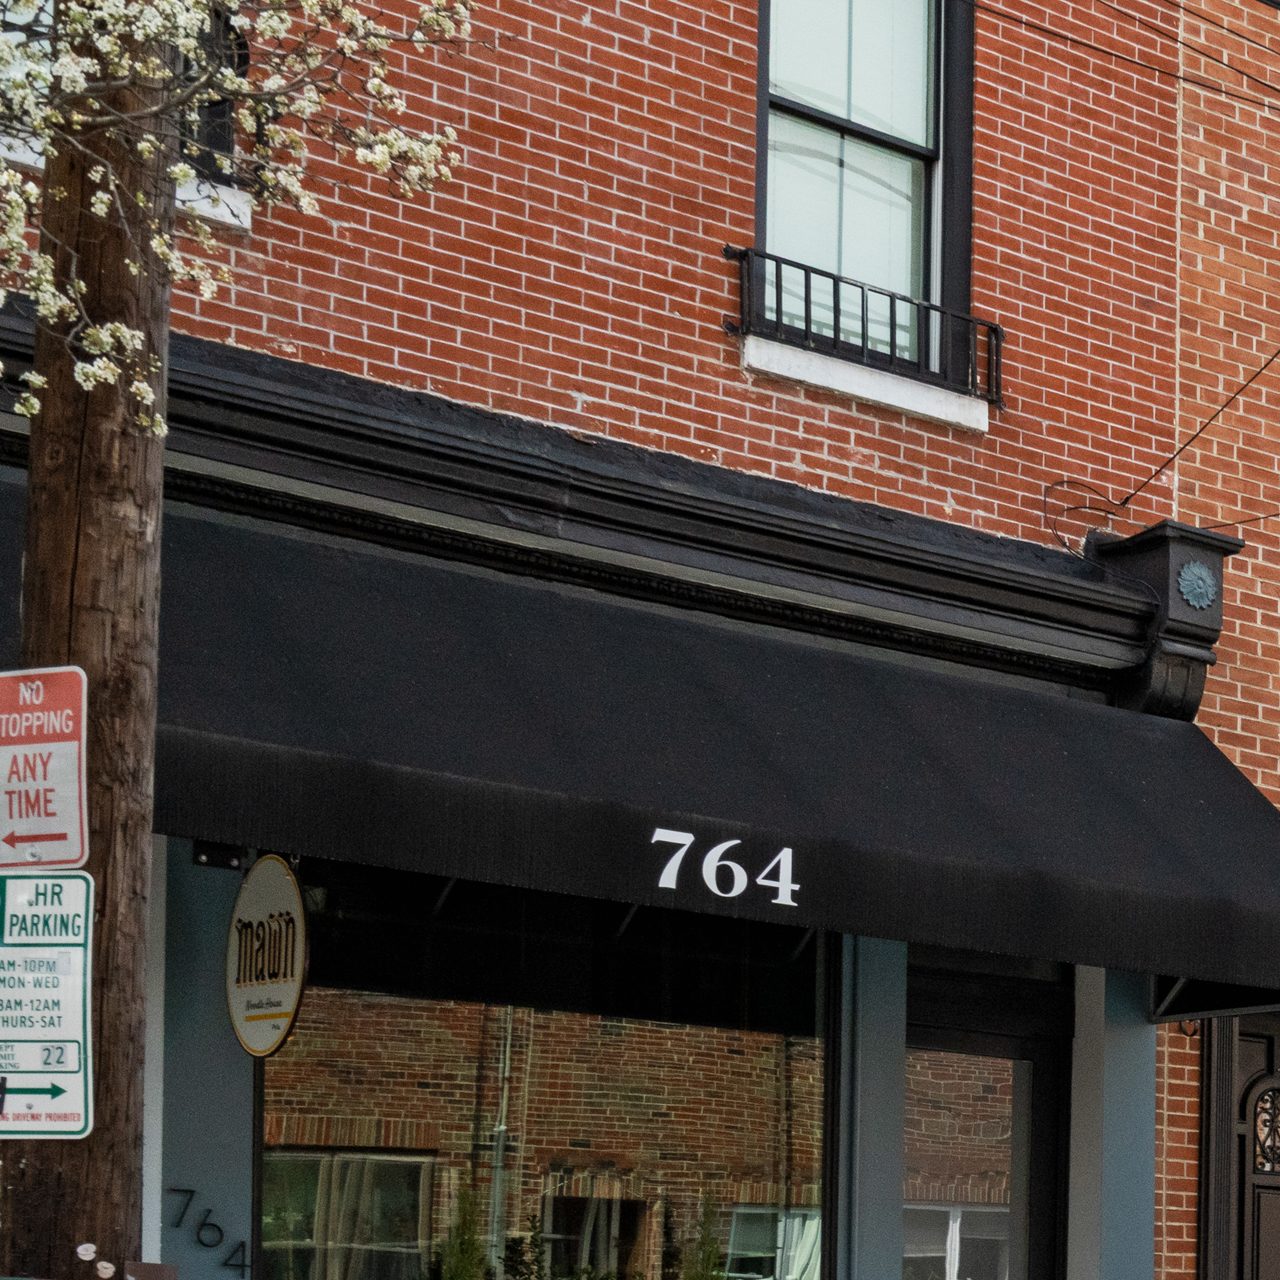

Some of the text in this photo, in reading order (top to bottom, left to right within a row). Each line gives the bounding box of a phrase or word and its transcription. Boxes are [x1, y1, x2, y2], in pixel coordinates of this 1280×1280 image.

[19, 681, 44, 705] NO
[0, 709, 73, 737] TOPPING
[8, 752, 53, 783] ANY
[4, 788, 57, 819] TIME
[651, 828, 801, 907] 764
[35, 883, 63, 906] HR
[9, 913, 81, 937] PARKING
[0, 960, 56, 972] AM-10PM
[43, 1046, 65, 1066] 22
[167, 1188, 251, 1279] 764
